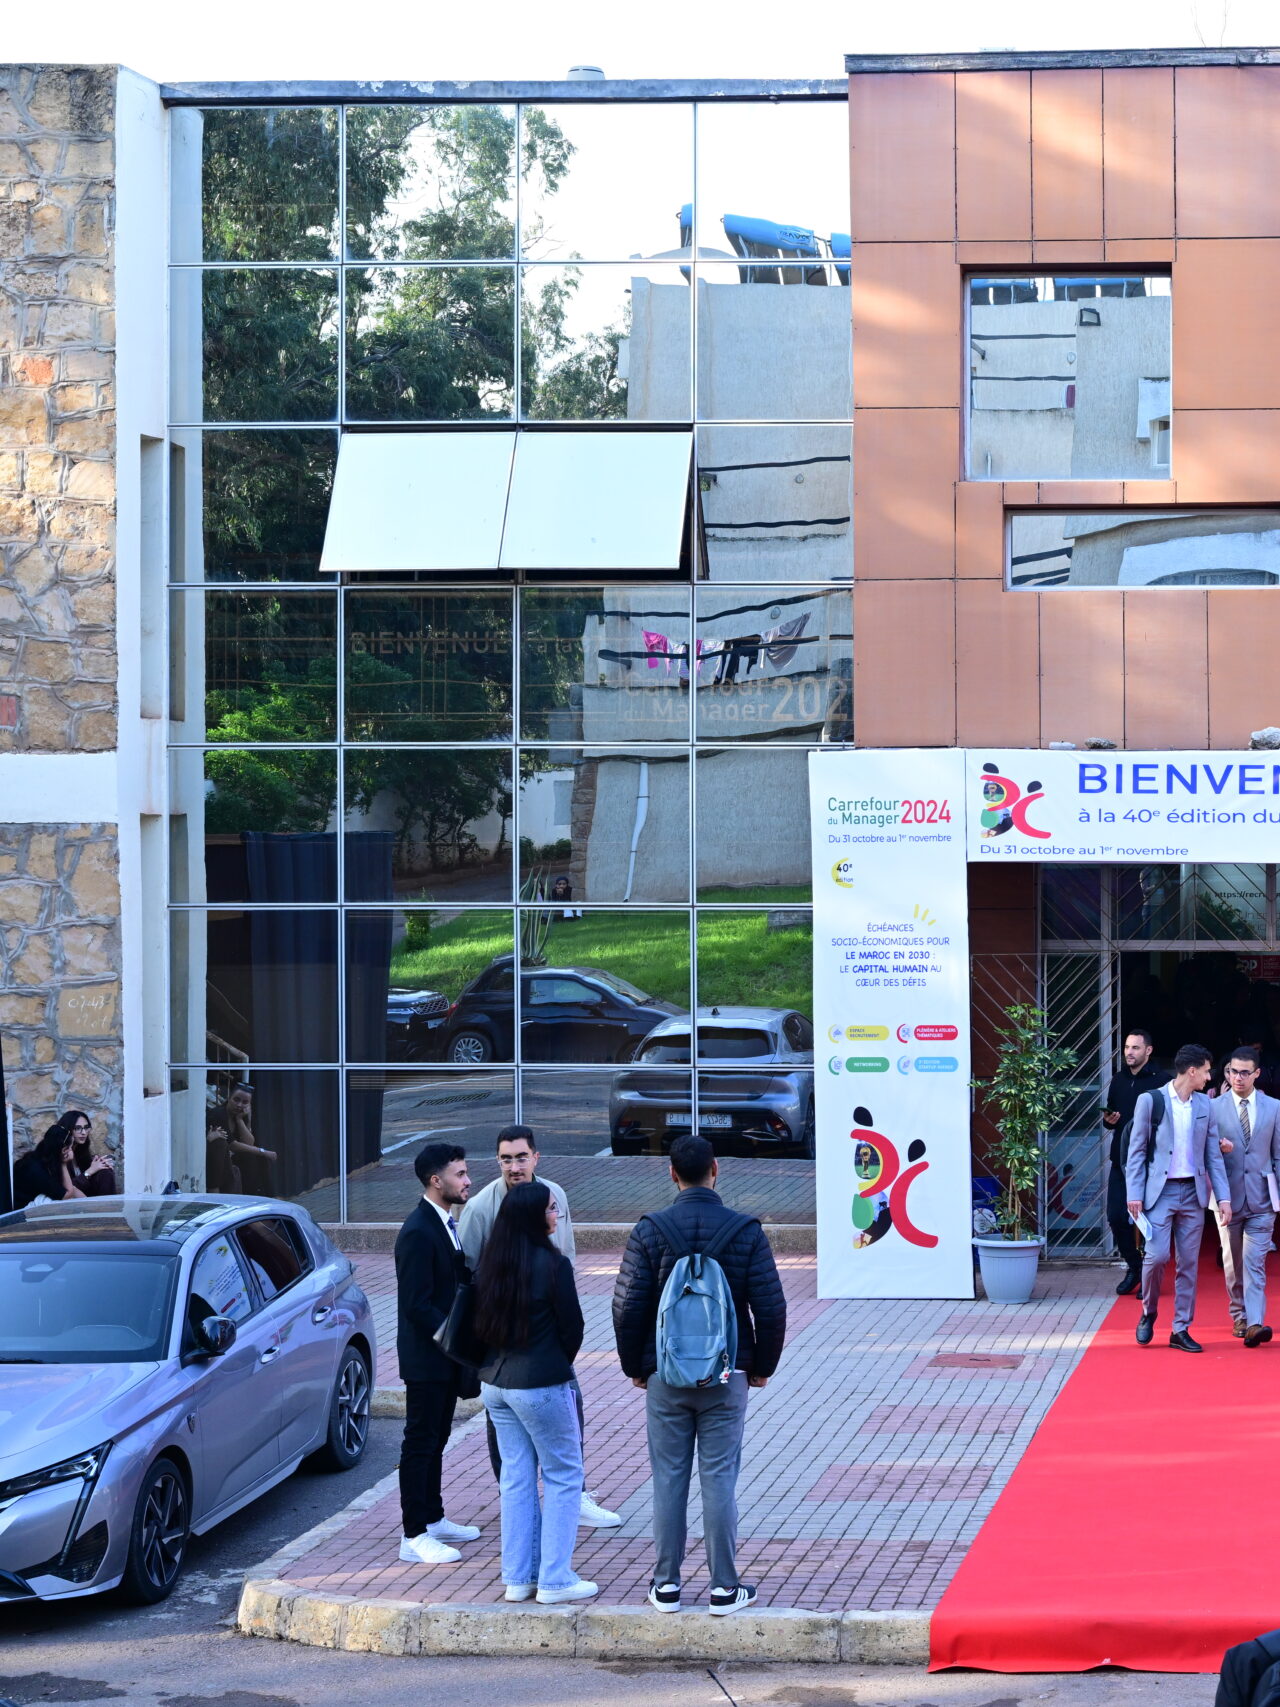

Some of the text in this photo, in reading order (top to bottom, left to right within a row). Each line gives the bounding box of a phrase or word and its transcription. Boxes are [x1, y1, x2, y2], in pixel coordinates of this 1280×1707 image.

[773, 676, 848, 720] 202
[828, 797, 951, 824] Carrefour 2024
[1078, 808, 1091, 823] à
[1100, 808, 1115, 823] la
[1167, 807, 1245, 824] édition
[828, 812, 899, 827] du Manager
[828, 834, 840, 843] Du
[842, 834, 851, 843] 31
[852, 834, 885, 843] octobre
[908, 834, 951, 843] novembre
[980, 845, 1000, 855] Du
[1003, 845, 1017, 856] 31
[1020, 845, 1075, 856] octobre
[1078, 848, 1096, 856] au
[1117, 846, 1188, 856] novembre
[867, 922, 914, 932] ÉCHÉANCES
[832, 936, 950, 946] SOCIO-ÉCONOMIQUES POUR
[845, 951, 855, 959] LE
[859, 951, 890, 960] MAROC
[894, 951, 905, 959] EN
[909, 951, 930, 960] 2030
[839, 965, 941, 973] LE CAPITAL HUMAIN AU
[856, 977, 927, 987] CŒUR DES DÉFIS
